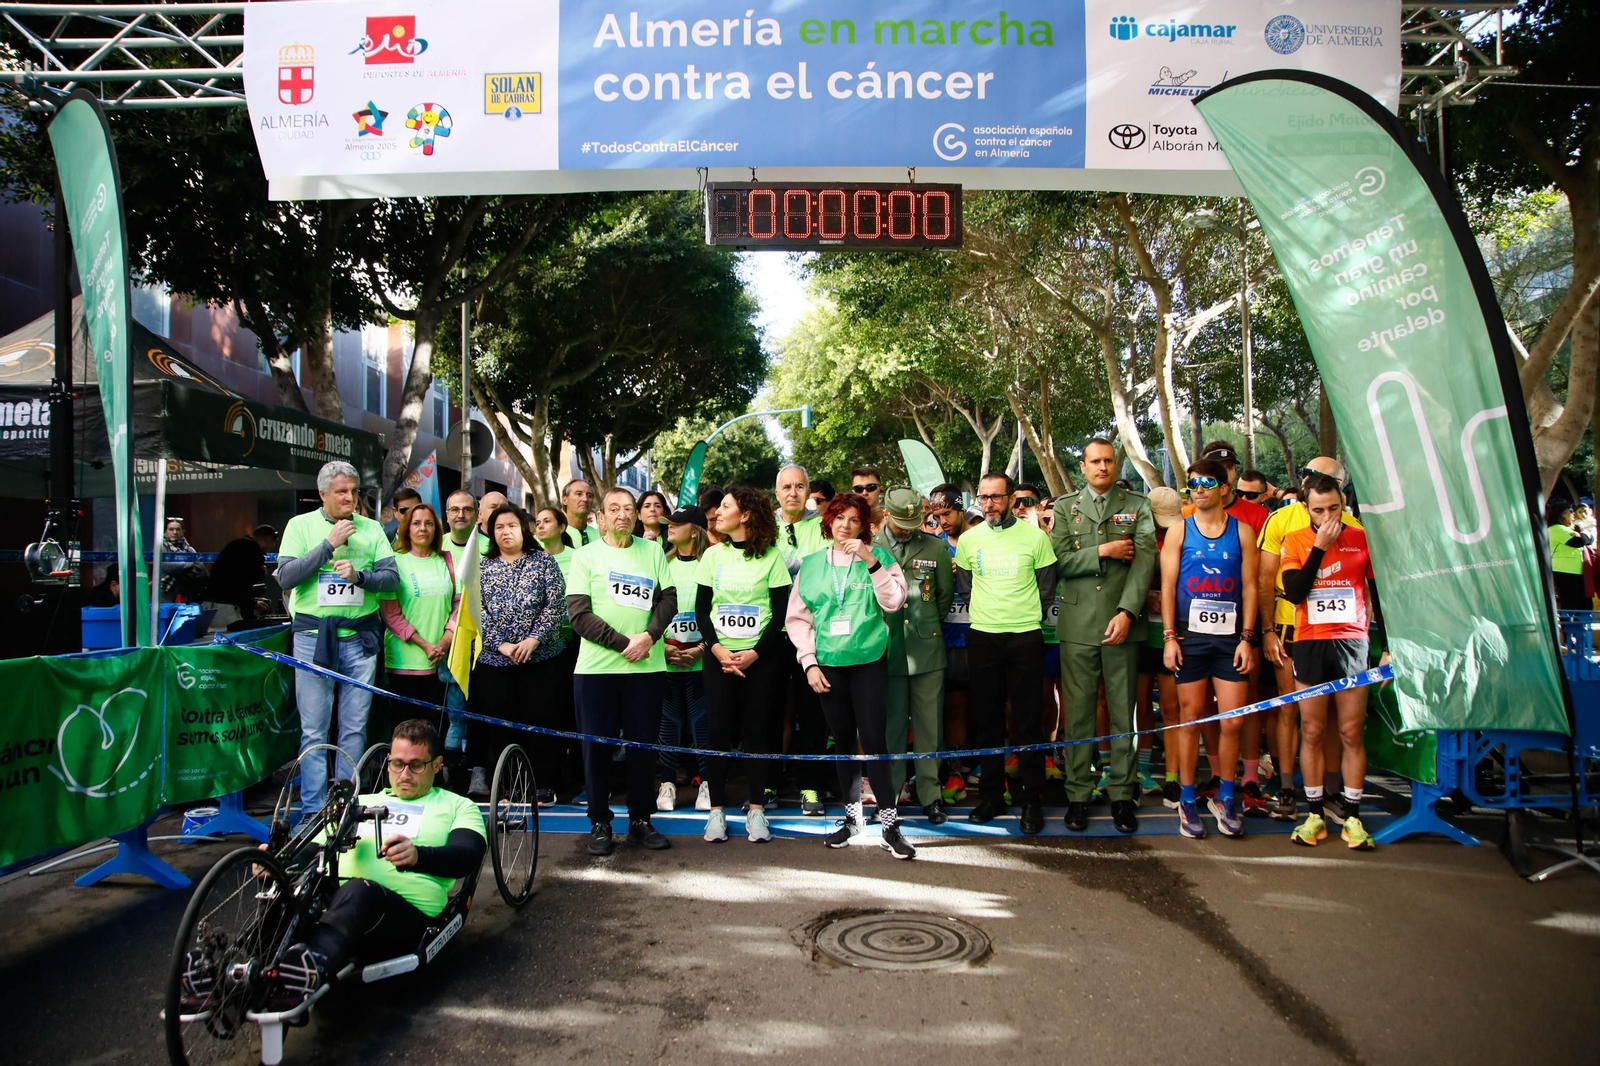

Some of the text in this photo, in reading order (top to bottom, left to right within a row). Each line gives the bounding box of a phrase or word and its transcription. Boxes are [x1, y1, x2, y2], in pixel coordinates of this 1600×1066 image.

[593, 10, 1055, 48] Almería en marcha
[1145, 18, 1237, 42] cajamar
[1306, 24, 1383, 36] UNIVERSIDAD
[1306, 35, 1323, 46] DE
[362, 70, 410, 79] DEPORTES
[593, 61, 995, 102] contra el cáncer
[491, 93, 535, 104] DE CABRAS
[260, 110, 329, 130] ALMERÍA
[278, 130, 315, 141] CIUDAD
[973, 124, 1074, 138] asociación española
[1153, 124, 1198, 137] Toyota
[581, 139, 739, 155] #TodosContraElCáncer
[975, 135, 1053, 147] contra el cáncer
[1153, 140, 1203, 152] Alborán
[975, 146, 1031, 158] en Almería
[0, 428, 50, 441] eportiv
[327, 583, 356, 596] 871
[1187, 576, 1235, 593] GALO
[1313, 579, 1351, 588] Europack
[612, 582, 650, 600] 1545
[1316, 599, 1347, 612] 543
[719, 614, 757, 628] 1600
[1199, 611, 1227, 624] 691
[671, 621, 700, 634] 150
[221, 724, 246, 743] solo
